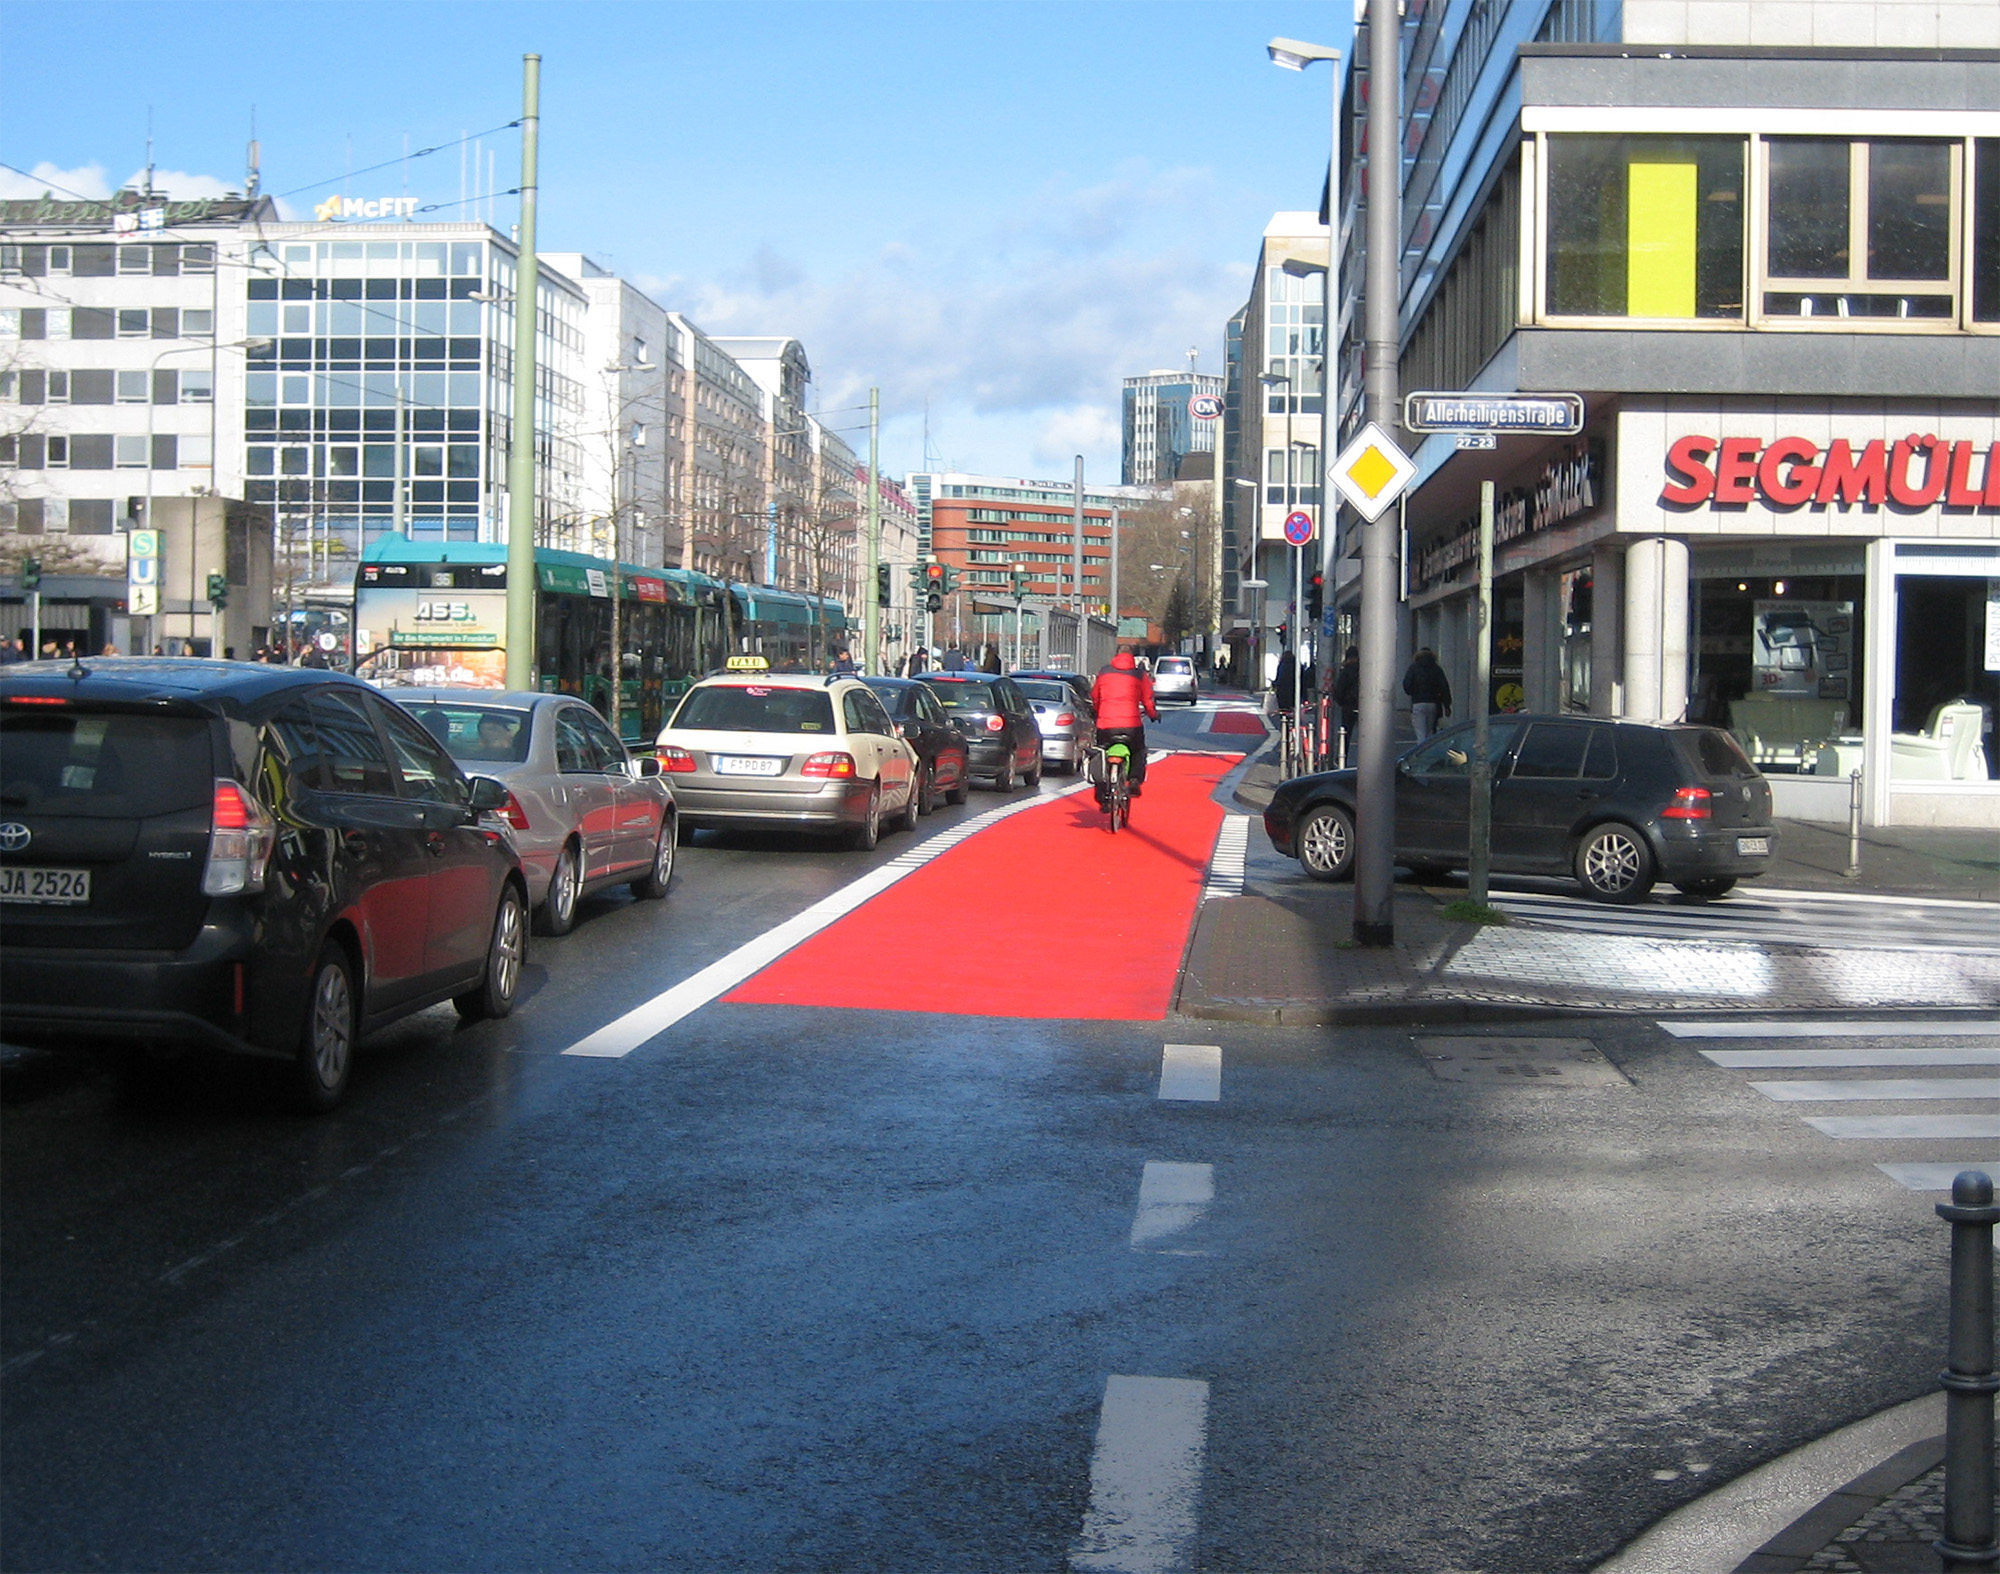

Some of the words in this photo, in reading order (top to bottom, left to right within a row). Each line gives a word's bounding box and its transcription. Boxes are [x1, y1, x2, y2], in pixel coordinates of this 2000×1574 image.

[343, 197, 419, 217] McFIT
[1426, 402, 1565, 426] Allerheiligenstraße
[1457, 437, 1494, 448] 27-23
[132, 559, 155, 584] U
[463, 635, 496, 643] Frankfurt
[731, 658, 760, 666] TAXI
[413, 665, 474, 682] as5.de
[760, 760, 773, 771] 87
[32, 872, 86, 897] 2526
